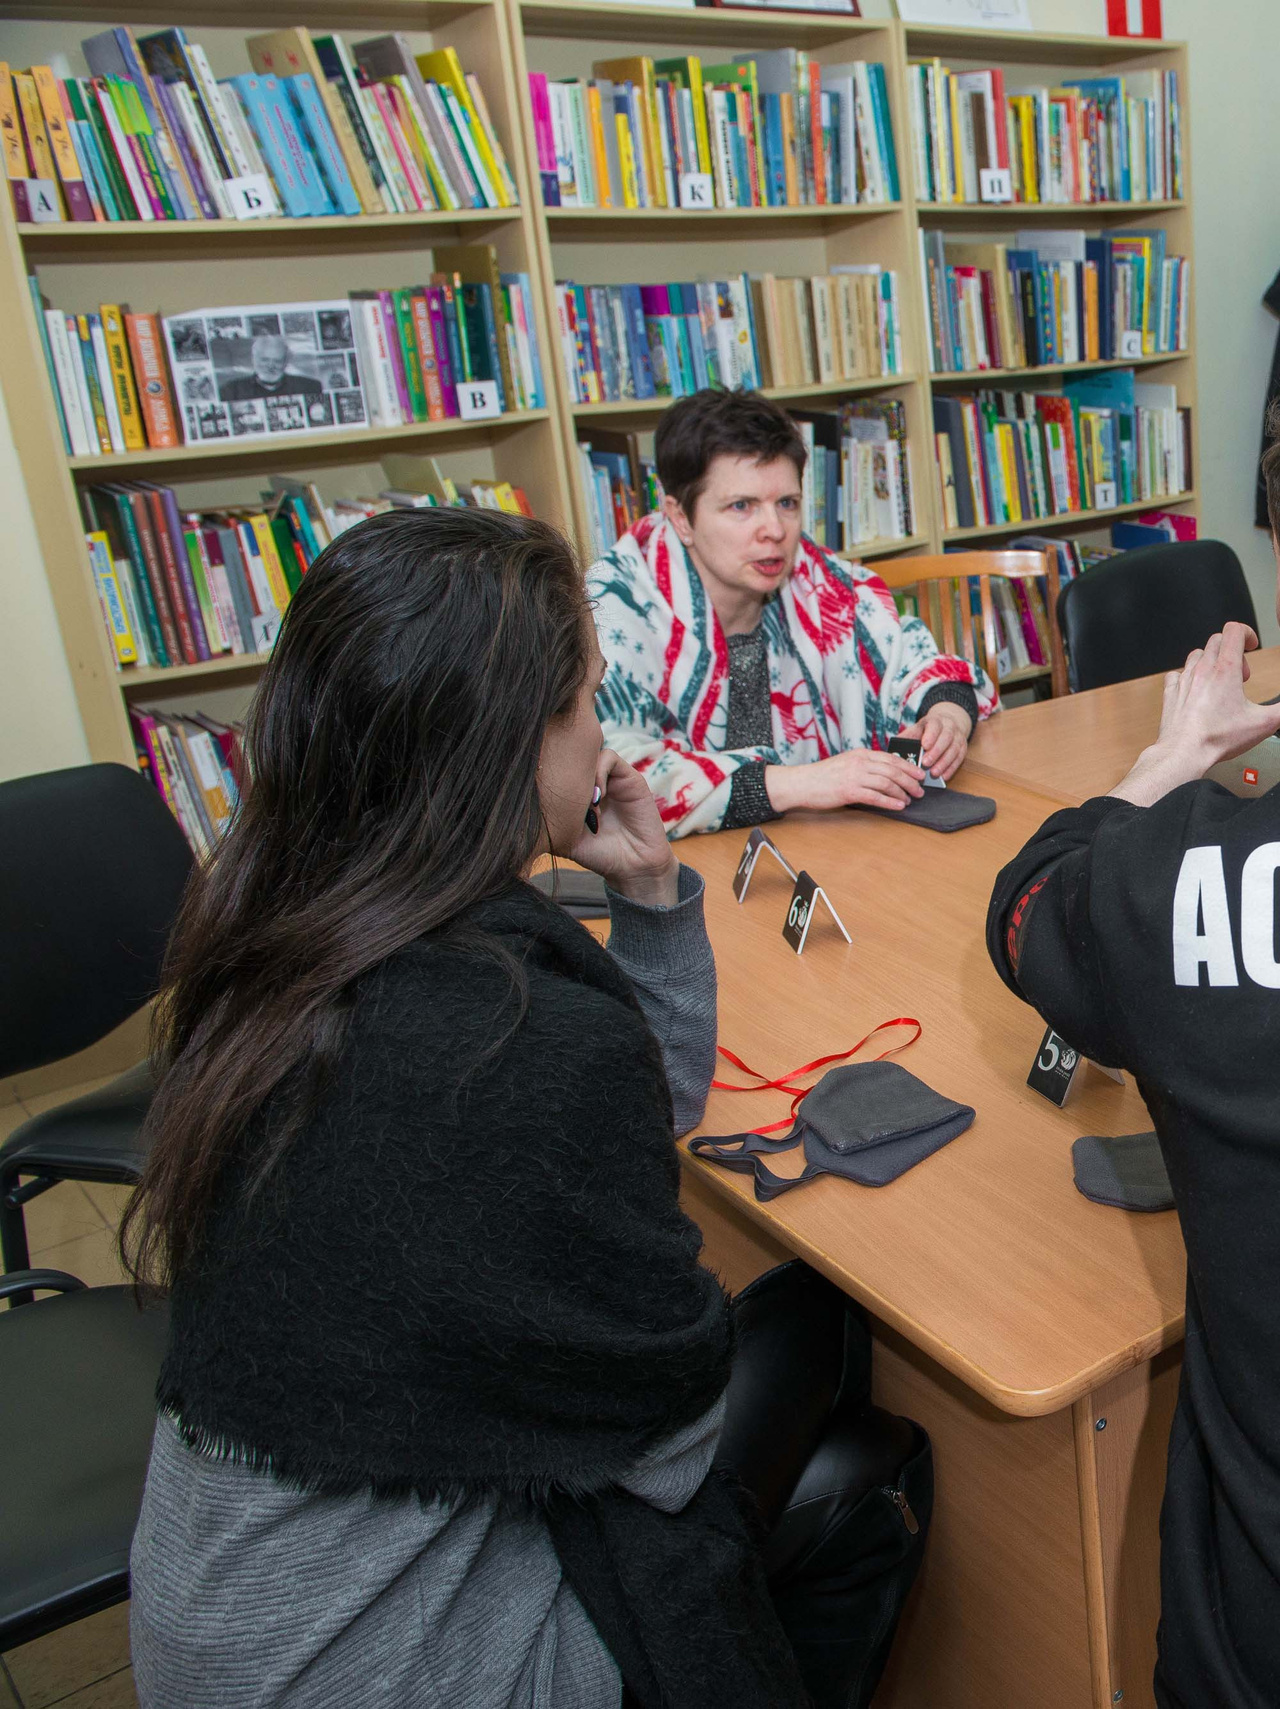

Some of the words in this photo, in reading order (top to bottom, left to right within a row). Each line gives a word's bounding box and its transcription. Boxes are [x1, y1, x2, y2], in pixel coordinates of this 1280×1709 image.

[37, 190, 53, 212] А
[241, 188, 262, 209] Б
[690, 184, 705, 201] К
[1126, 338, 1137, 353] С
[470, 391, 486, 409] В
[1100, 489, 1110, 503] Т
[737, 841, 752, 875] 7
[788, 895, 802, 928] 6
[1038, 1030, 1064, 1072] 5
